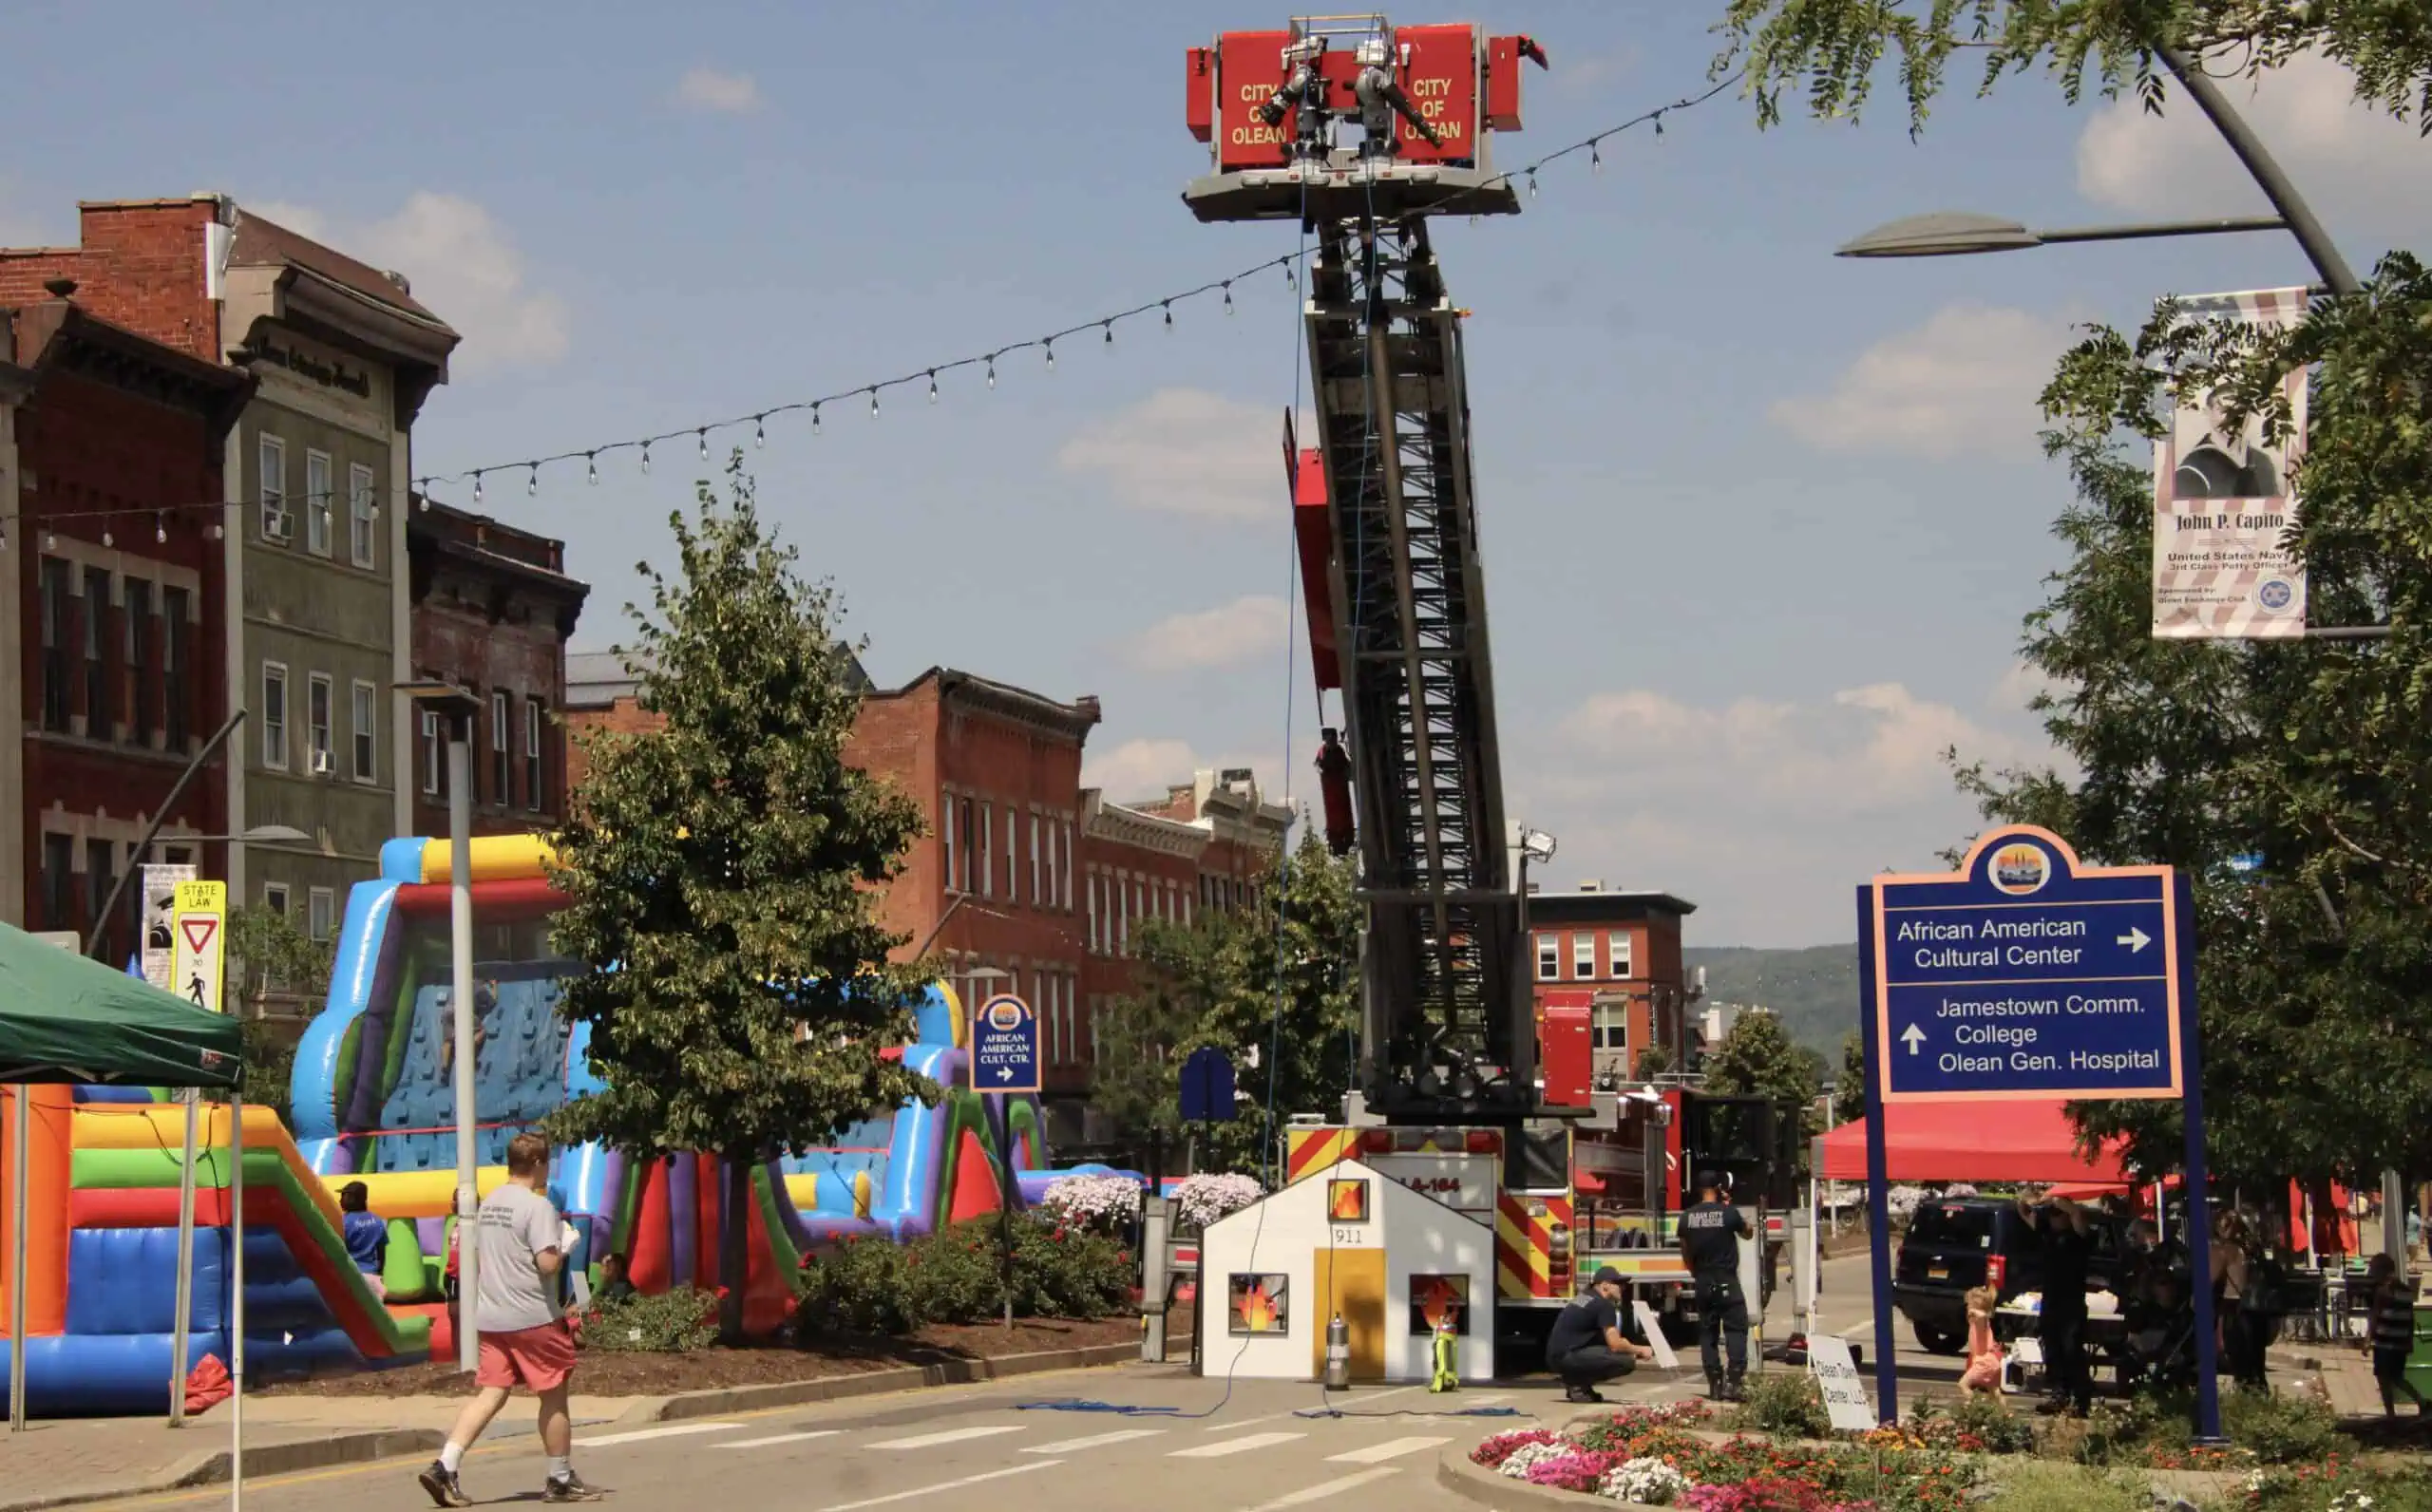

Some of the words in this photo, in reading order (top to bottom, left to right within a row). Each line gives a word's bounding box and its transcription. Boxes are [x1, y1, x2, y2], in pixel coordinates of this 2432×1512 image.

[1241, 84, 1278, 101] CITY
[1414, 79, 1452, 96] CITY
[1421, 100, 1444, 118] OF
[1232, 125, 1287, 144] OLEAN
[2176, 514, 2212, 532] John
[2217, 514, 2230, 529] P.
[2235, 513, 2284, 531] Capito
[2168, 551, 2210, 561] United
[2214, 551, 2253, 560] States
[2259, 550, 2290, 562] Navy
[2190, 562, 2219, 571] Class
[2222, 562, 2249, 572] Petty
[2252, 561, 2289, 570] Officer
[184, 884, 217, 896] STATE
[189, 898, 211, 908] LAW
[1897, 920, 1973, 941] African
[1981, 917, 2086, 939] American
[1915, 948, 1999, 968] Cultural
[2006, 945, 2082, 966] Center
[1936, 997, 2059, 1018] Jamestown
[2066, 994, 2145, 1015] Comm.
[985, 1033, 1026, 1043] AFRICAN
[1955, 1024, 2038, 1048] College
[980, 1044, 1030, 1053] AMERICAN
[980, 1054, 1008, 1064] CULT.
[1009, 1054, 1030, 1064] CTR.
[1939, 1052, 2003, 1072] Olean
[2010, 1051, 2062, 1070] Gen.
[2071, 1049, 2159, 1073] Hospital
[1336, 1229, 1361, 1243] 911
